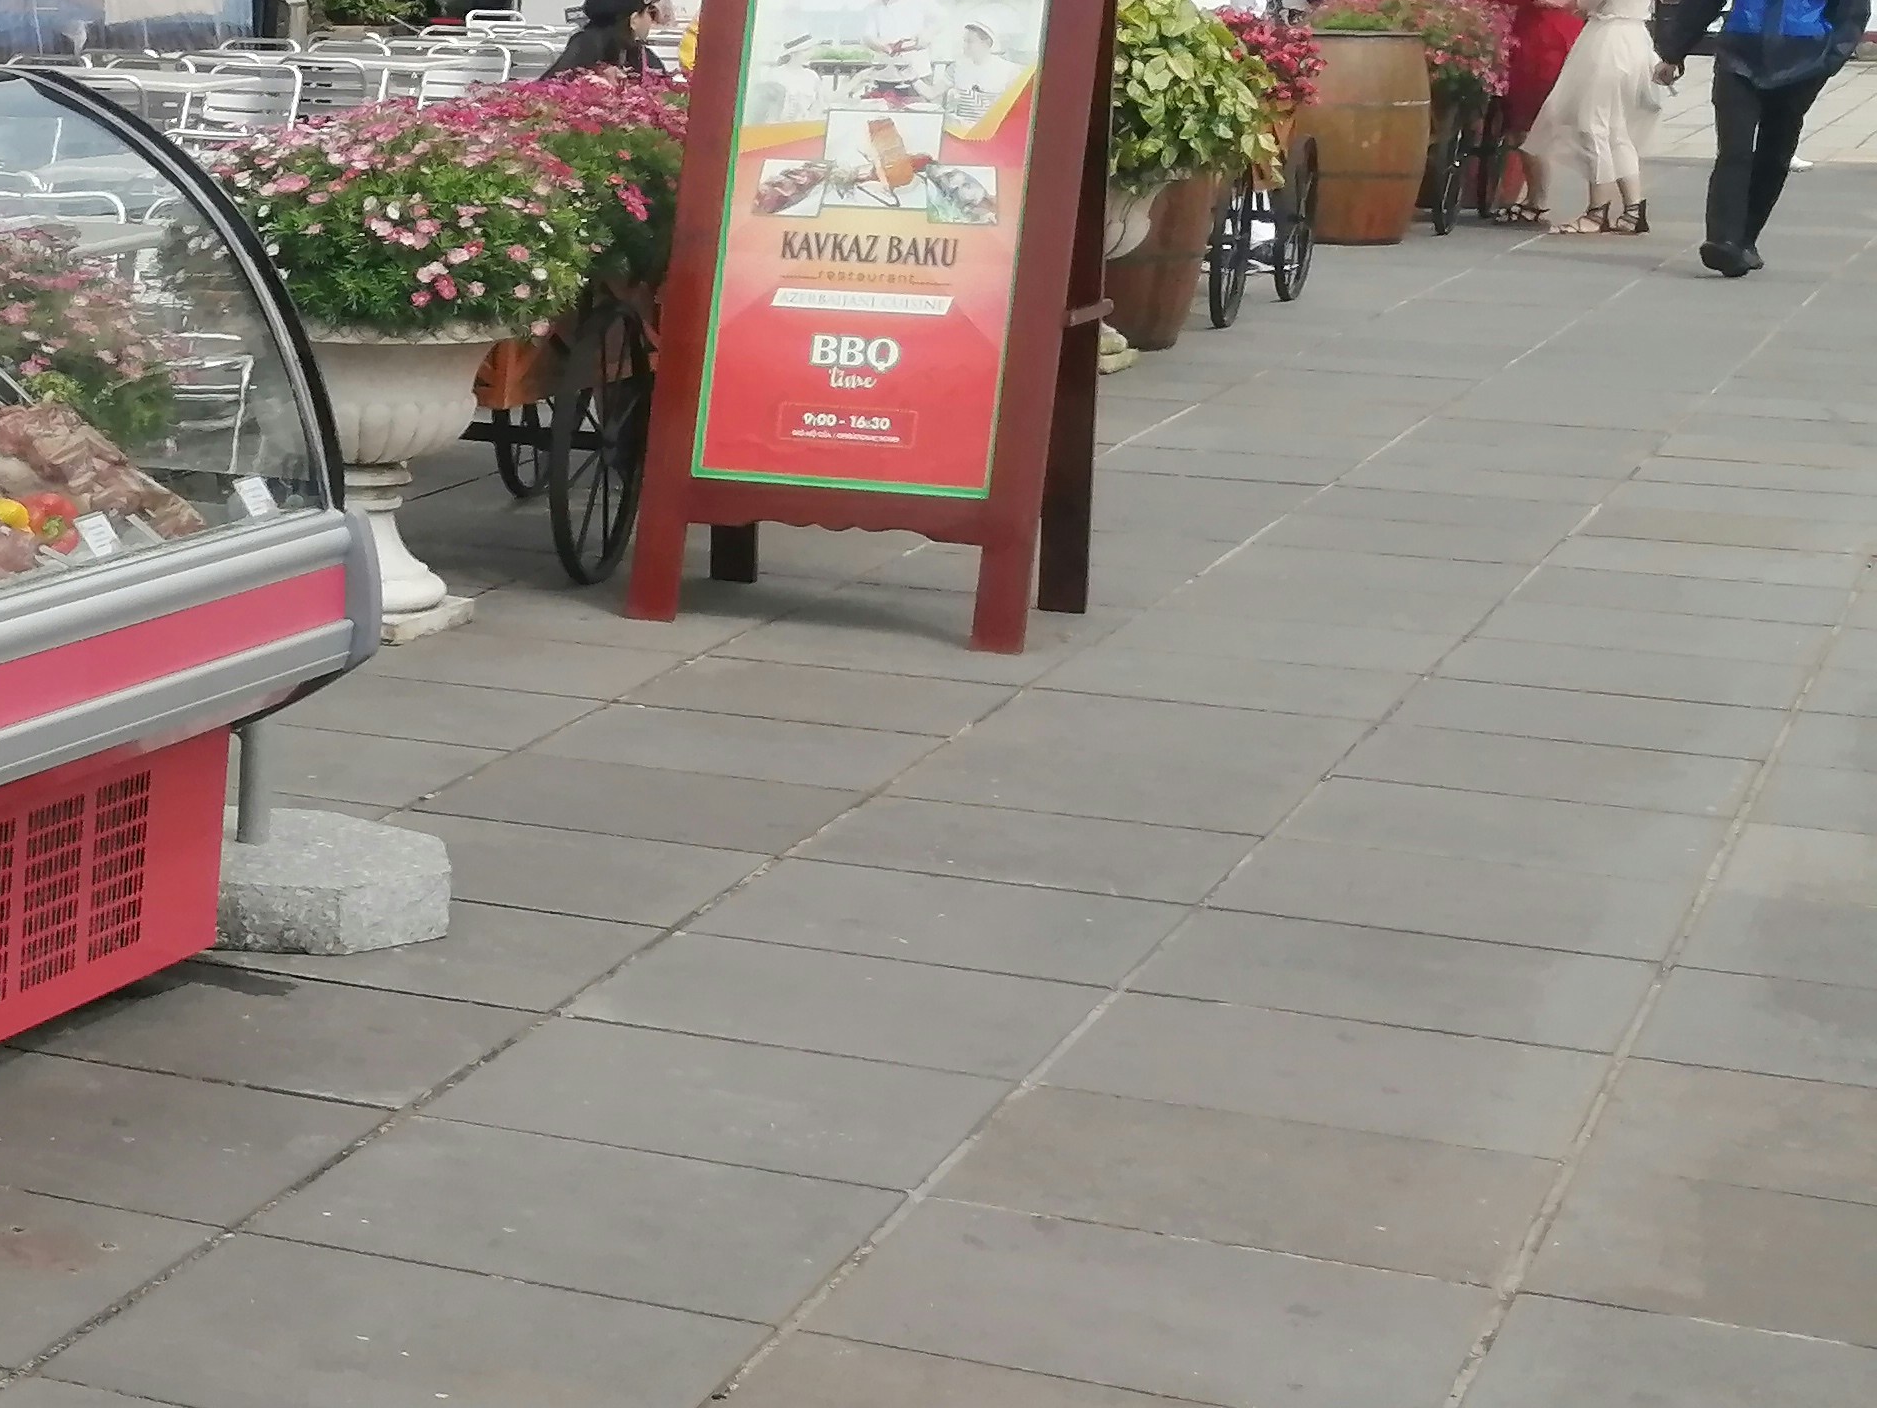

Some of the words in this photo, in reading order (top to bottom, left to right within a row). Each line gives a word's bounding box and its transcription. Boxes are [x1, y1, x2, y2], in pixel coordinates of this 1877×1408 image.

[781, 230, 881, 264] KAVKAZ
[886, 235, 959, 268] BAKU
[810, 333, 901, 372] BBQ
